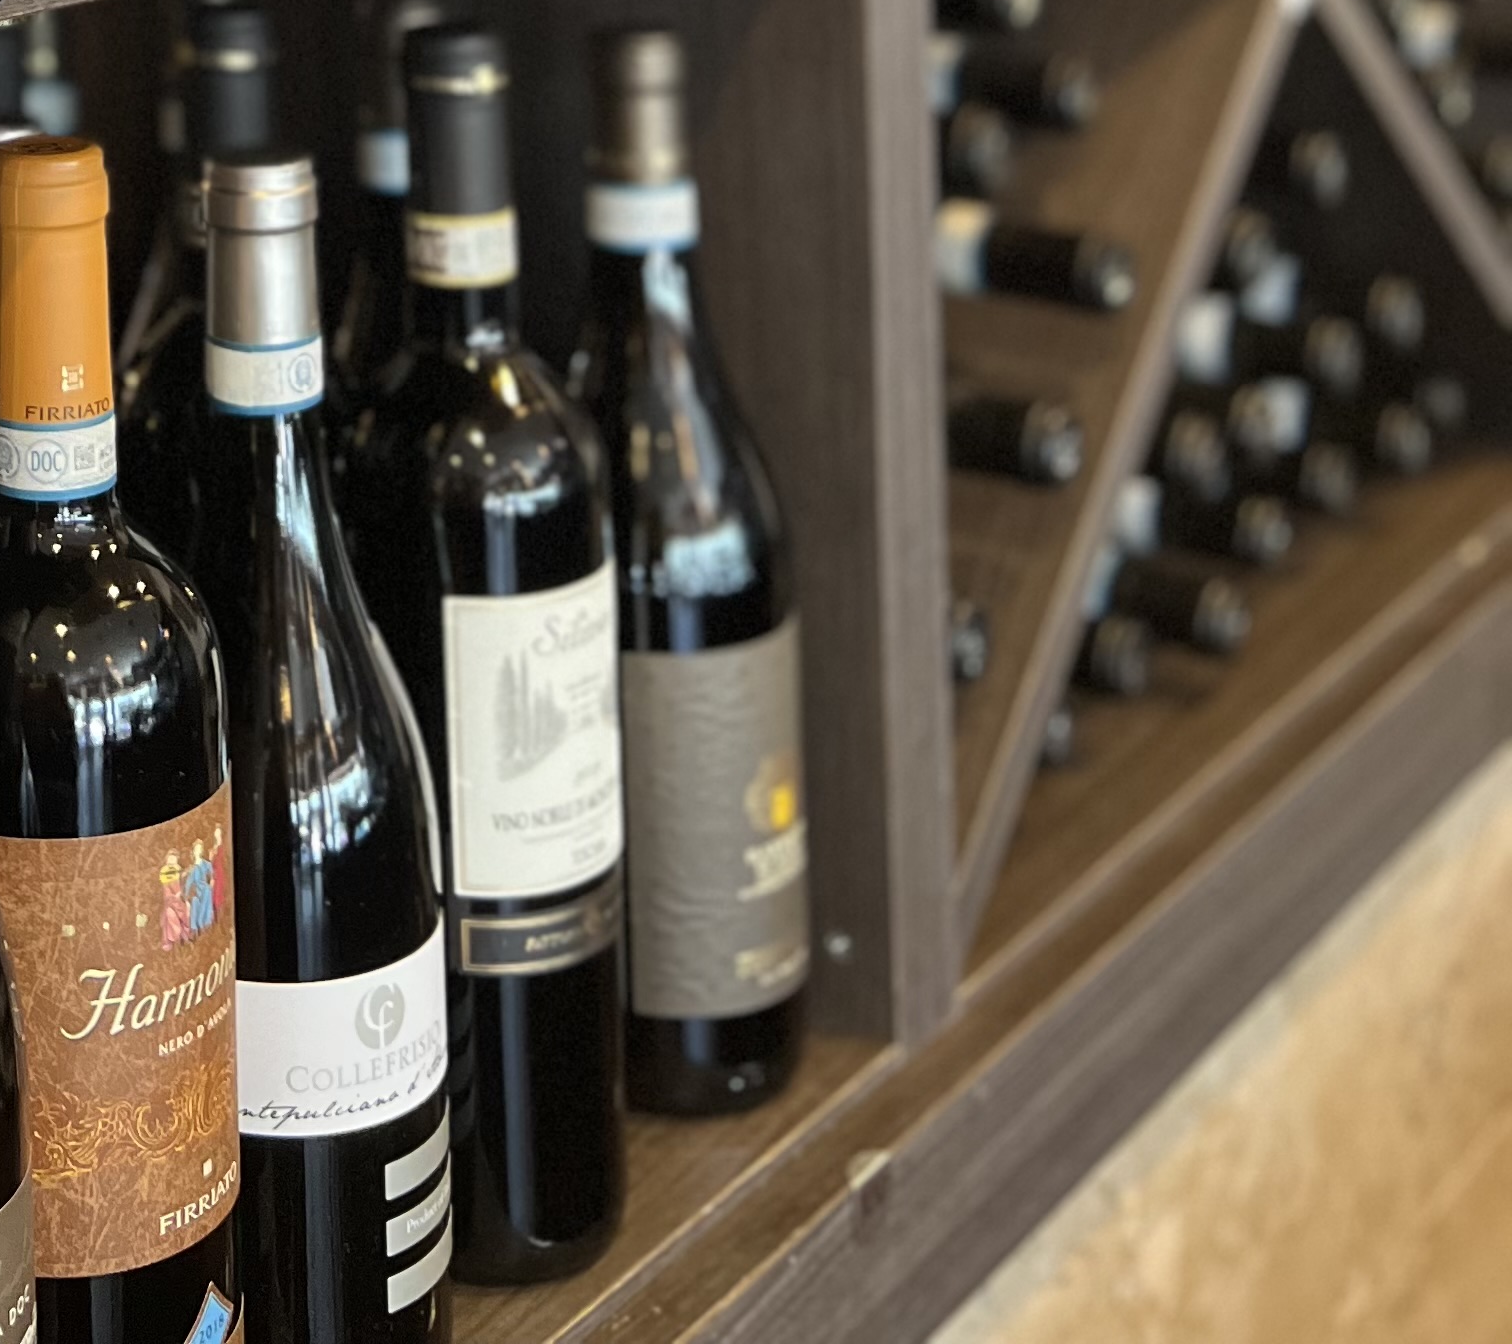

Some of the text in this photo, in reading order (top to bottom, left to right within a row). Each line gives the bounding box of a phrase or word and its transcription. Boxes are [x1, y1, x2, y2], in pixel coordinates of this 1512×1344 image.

[24, 396, 111, 421] FIRRIATO
[30, 449, 63, 472] DOC
[158, 1030, 194, 1057] NERO
[159, 1160, 237, 1236] FIRRIATO
[198, 1313, 226, 1344] 2018
